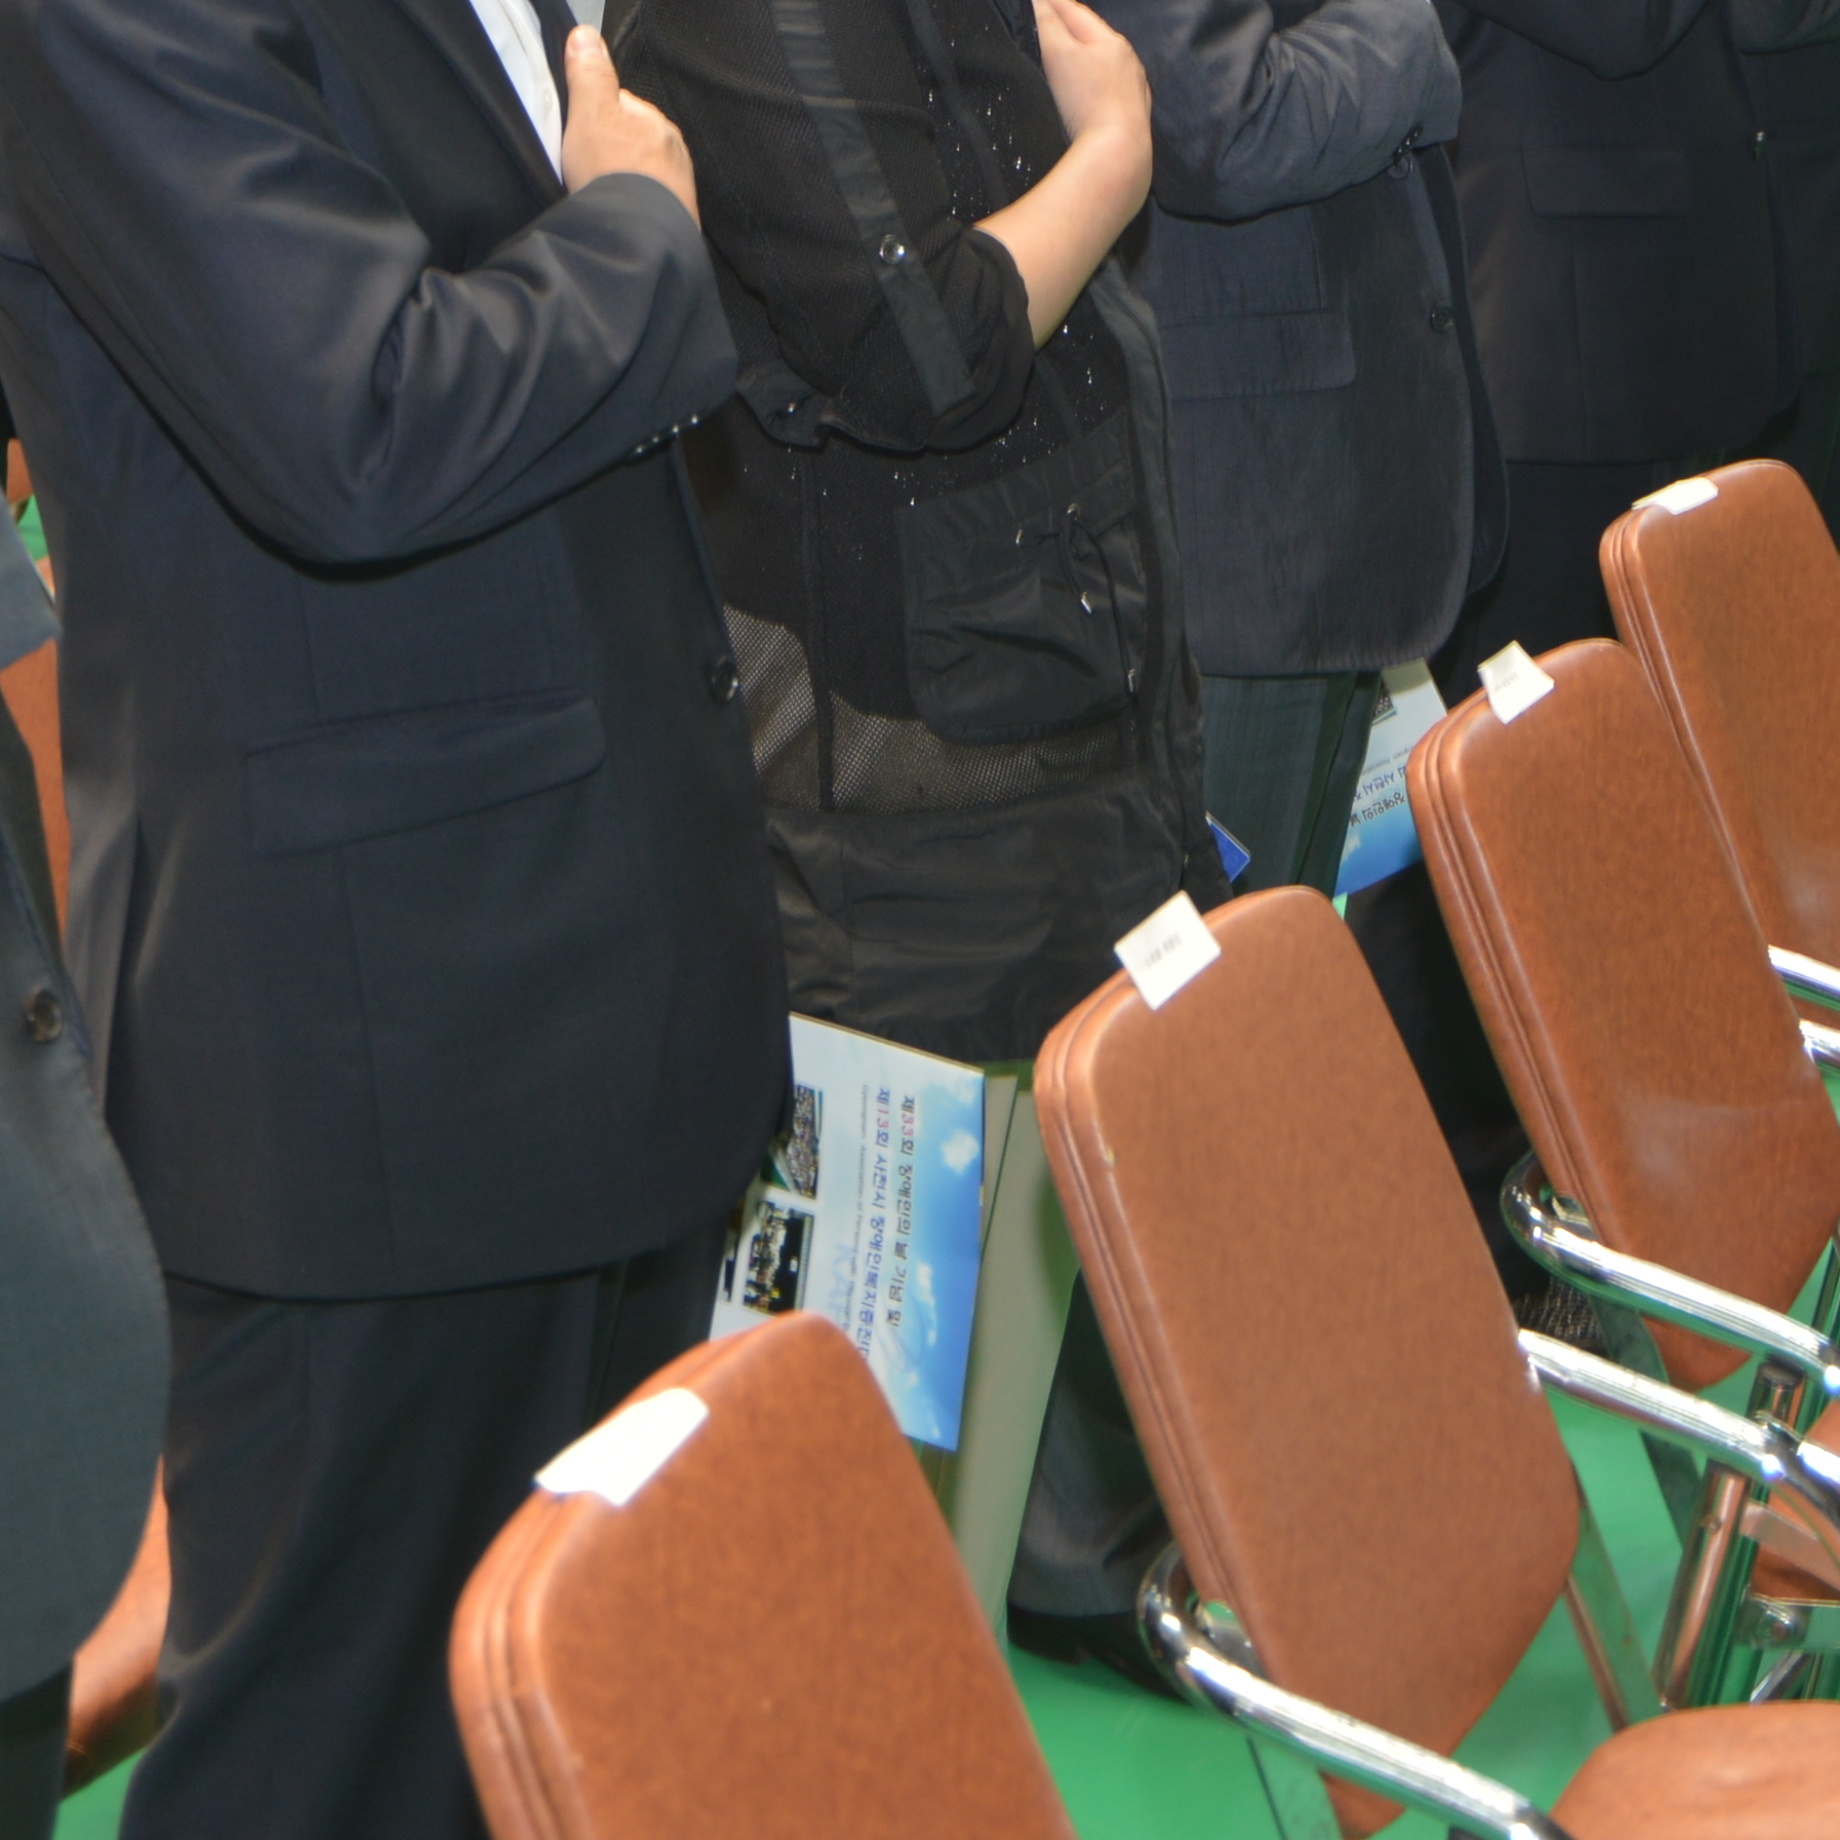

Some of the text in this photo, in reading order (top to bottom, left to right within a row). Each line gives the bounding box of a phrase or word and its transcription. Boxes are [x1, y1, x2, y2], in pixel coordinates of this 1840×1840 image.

[1362, 791, 1405, 821] 장애인의
[875, 1087, 890, 1148] 제13회
[900, 1095, 915, 1155] 제33회
[872, 1155, 888, 1209] 사천시
[896, 1163, 913, 1236] 장애인의
[888, 1265, 907, 1303] 기념
[886, 1308, 902, 1327] 및
